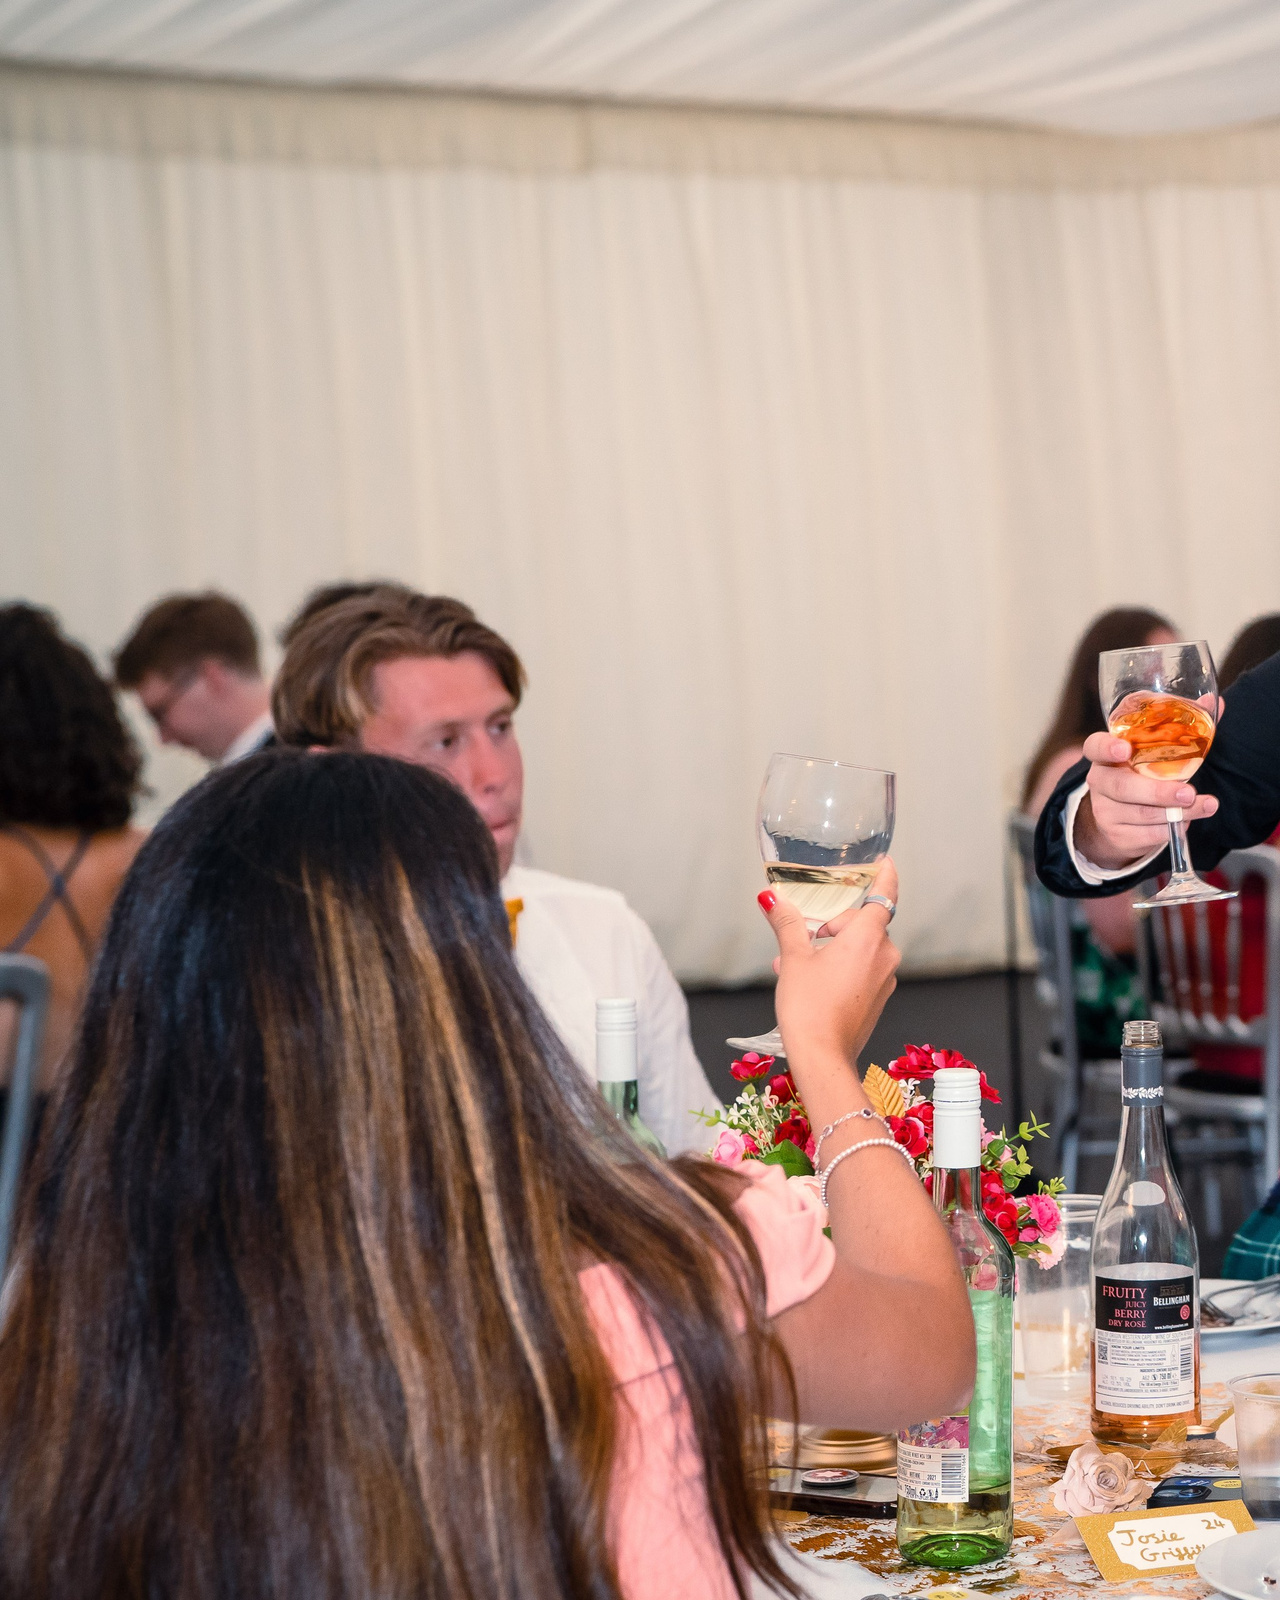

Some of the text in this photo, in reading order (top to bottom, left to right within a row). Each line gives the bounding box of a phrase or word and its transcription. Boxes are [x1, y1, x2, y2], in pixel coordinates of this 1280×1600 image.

[1102, 1285, 1147, 1299] FRUITY
[1153, 1294, 1190, 1306] BELLINGHAM
[1114, 1308, 1147, 1318] BERRY
[1108, 1319, 1123, 1327] DRY
[1116, 1519, 1226, 1547] Josie 24
[1140, 1544, 1206, 1562] Griffit
